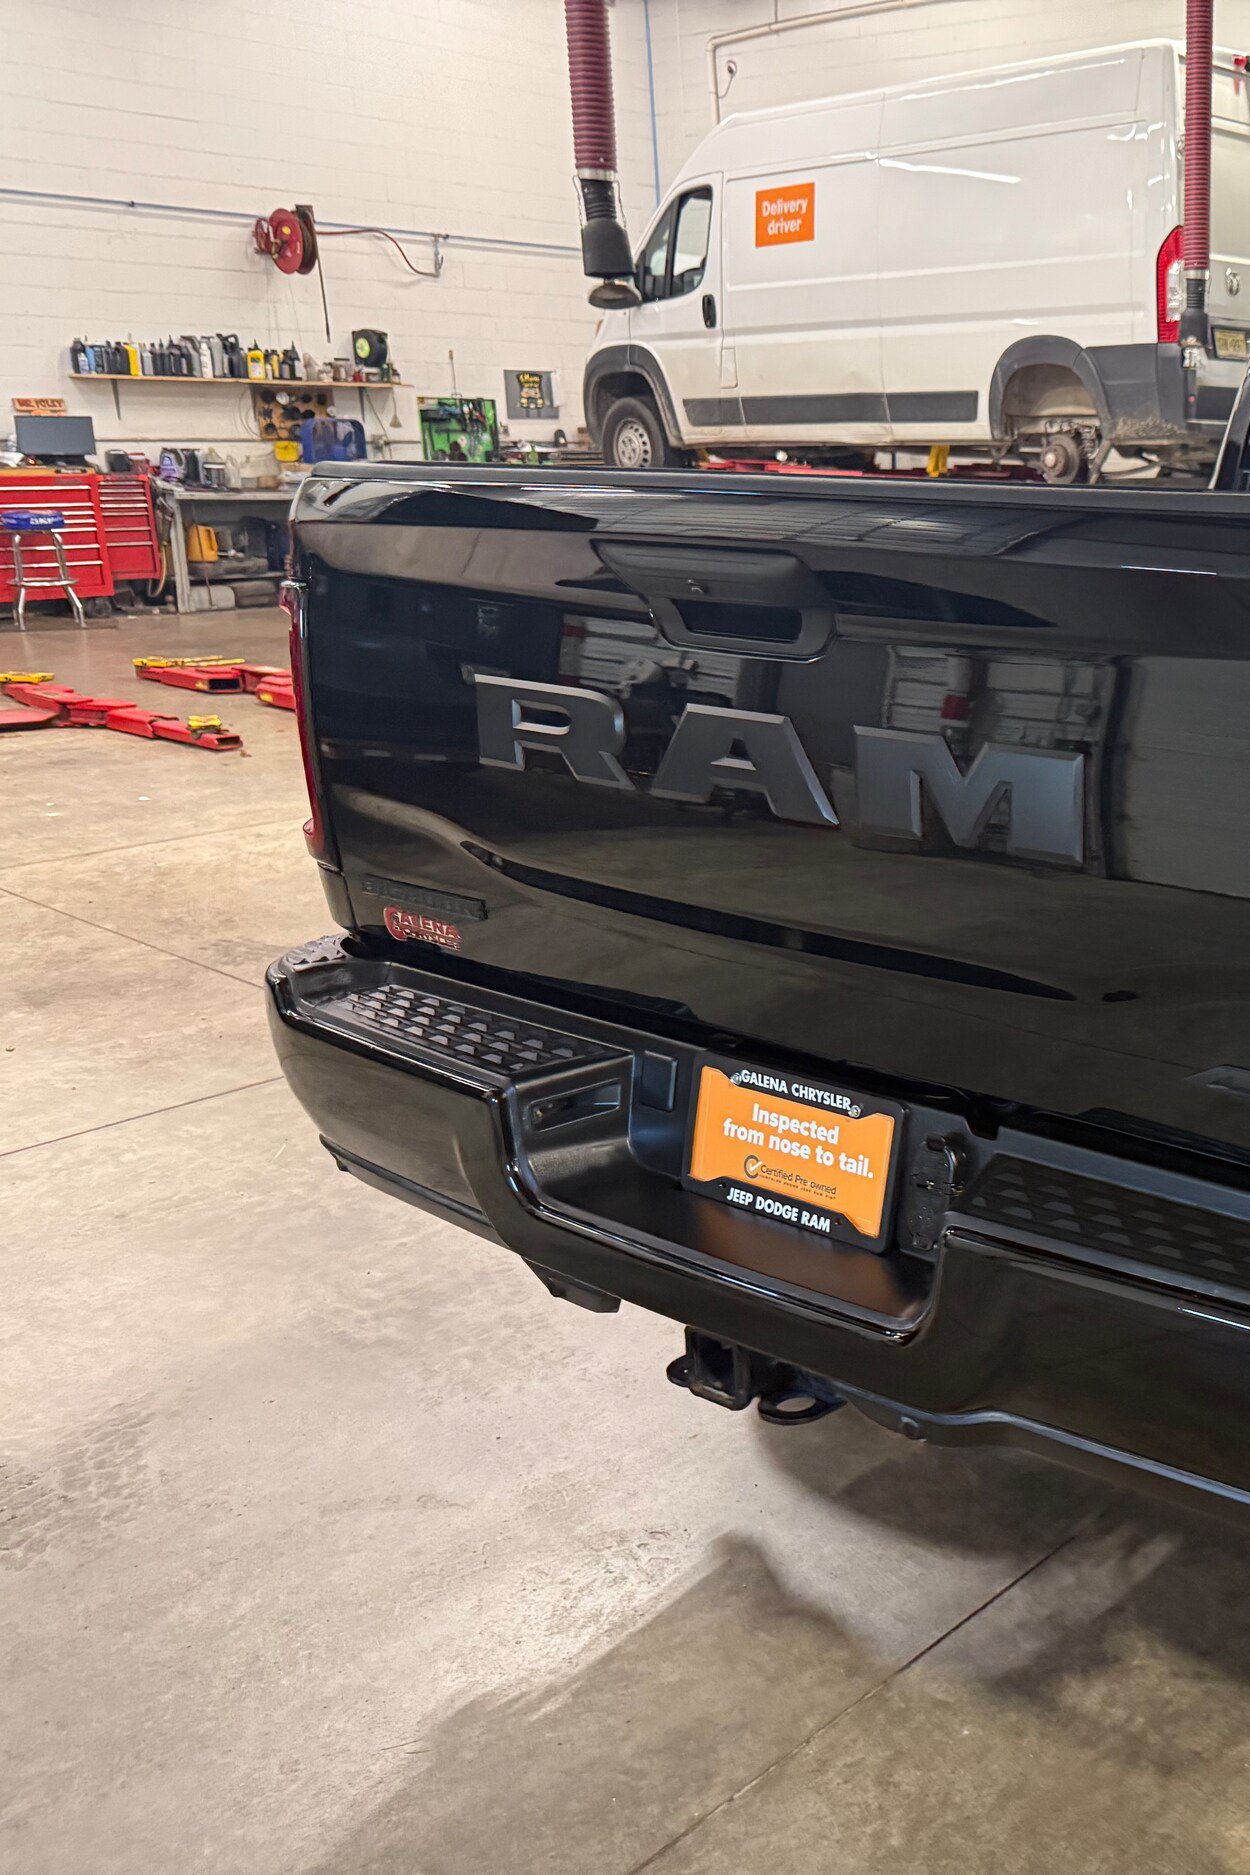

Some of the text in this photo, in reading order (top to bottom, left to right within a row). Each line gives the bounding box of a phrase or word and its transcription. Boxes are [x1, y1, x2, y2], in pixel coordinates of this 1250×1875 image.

[762, 197, 808, 217] Delivery
[767, 218, 802, 235] driver
[474, 674, 1086, 866] RAM
[741, 1069, 851, 1111] GALENA CHRYSLER
[752, 1103, 840, 1145] Inspected
[723, 1118, 874, 1178] from nose to tail.
[760, 1164, 793, 1182] Certified
[727, 1187, 831, 1233] JEEP DODGE RAM
